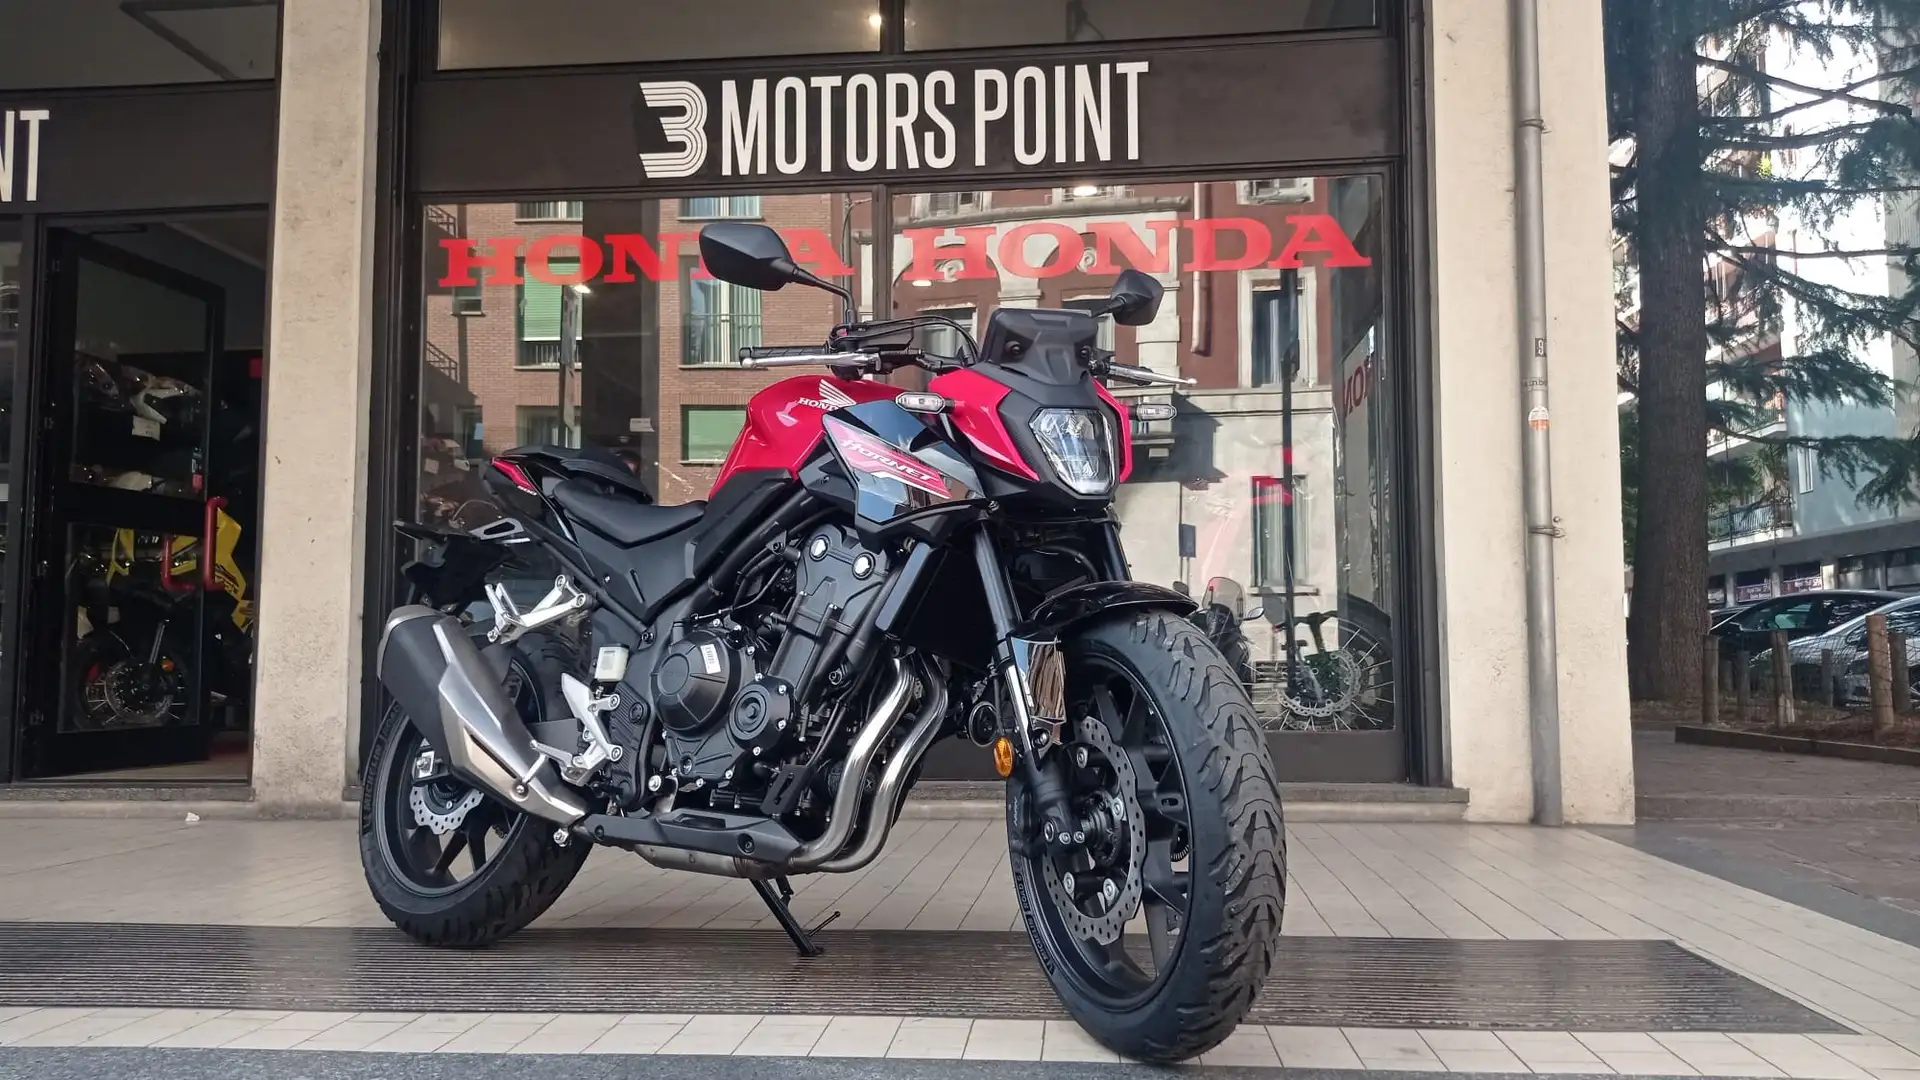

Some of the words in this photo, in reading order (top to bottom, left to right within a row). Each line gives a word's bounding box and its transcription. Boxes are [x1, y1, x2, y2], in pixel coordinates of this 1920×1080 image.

[722, 71, 956, 175] MOTORS
[975, 62, 1149, 166] POINT
[438, 227, 856, 287] HONA
[902, 212, 1372, 281] HONDA
[797, 397, 839, 411] HOND
[841, 439, 939, 482] HORNET
